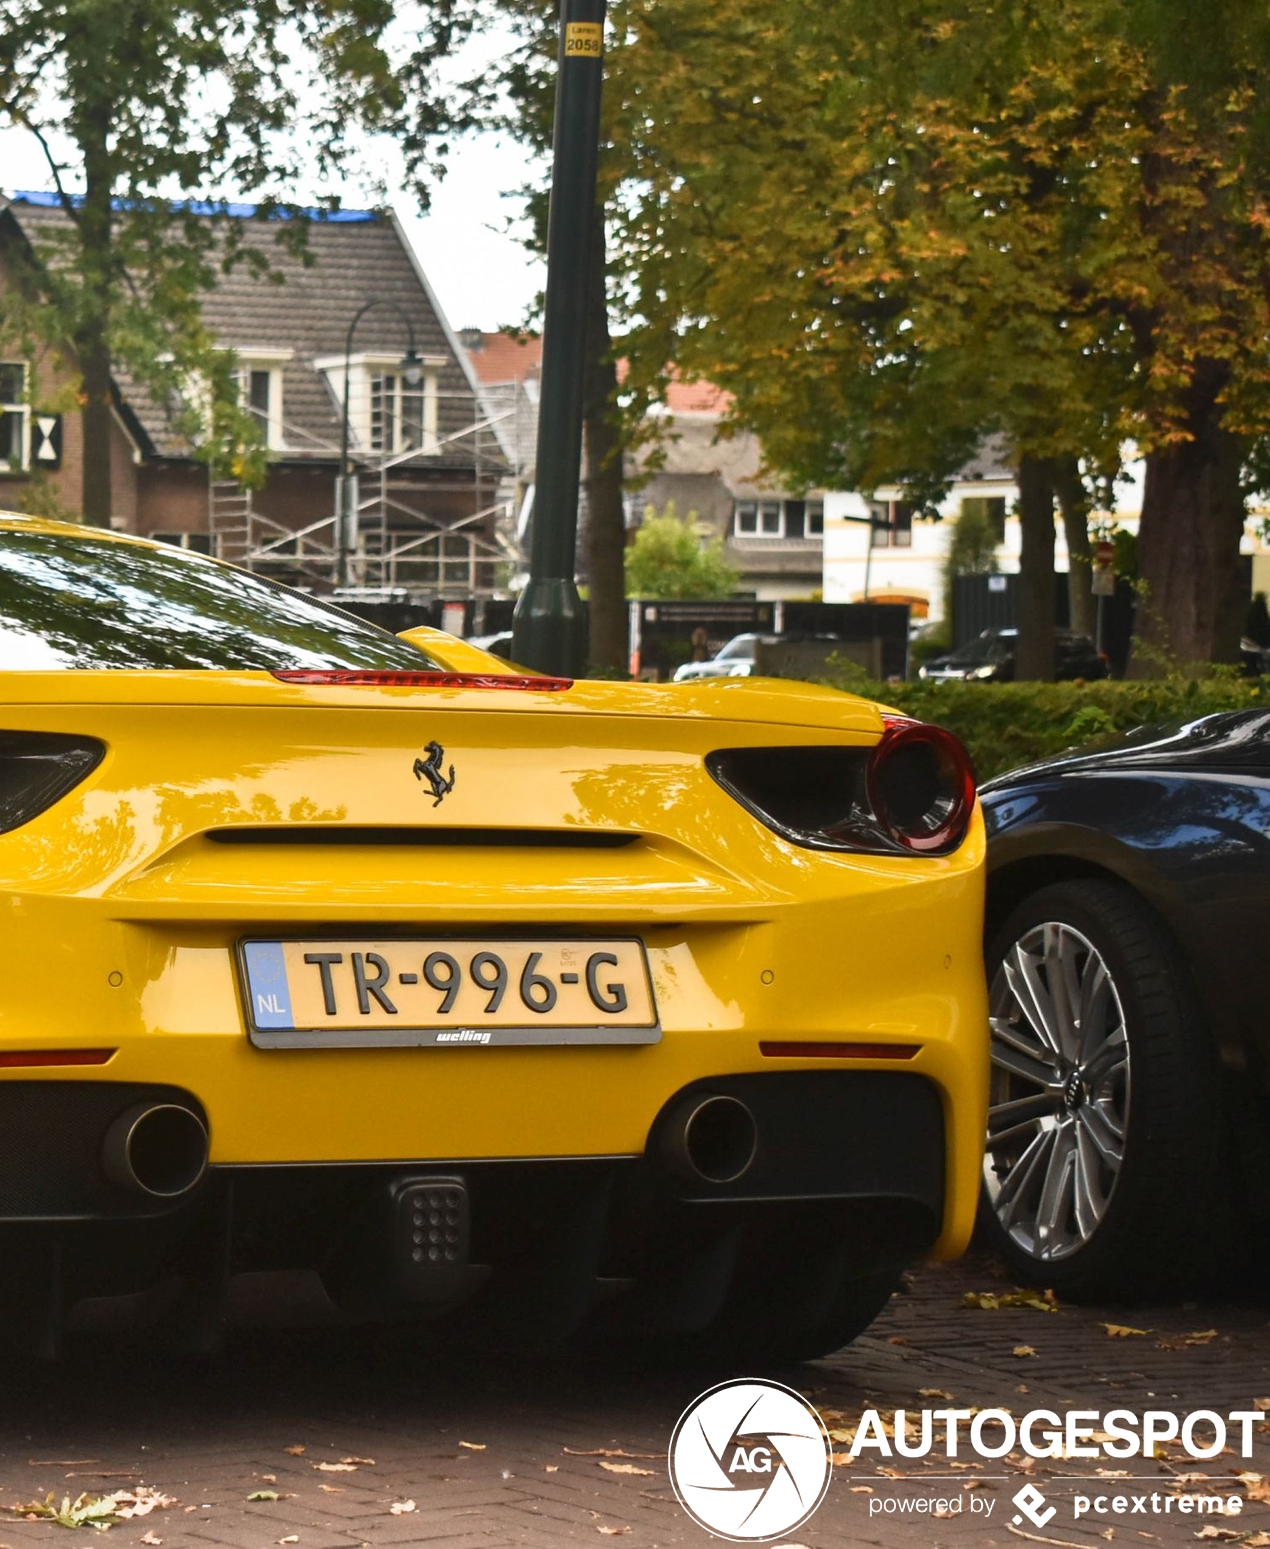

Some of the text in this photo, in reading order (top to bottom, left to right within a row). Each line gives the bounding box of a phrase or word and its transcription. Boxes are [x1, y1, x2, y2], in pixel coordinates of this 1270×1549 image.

[304, 951, 628, 1015] TR-996-G
[257, 994, 286, 1014] NL
[436, 1030, 492, 1044] welling
